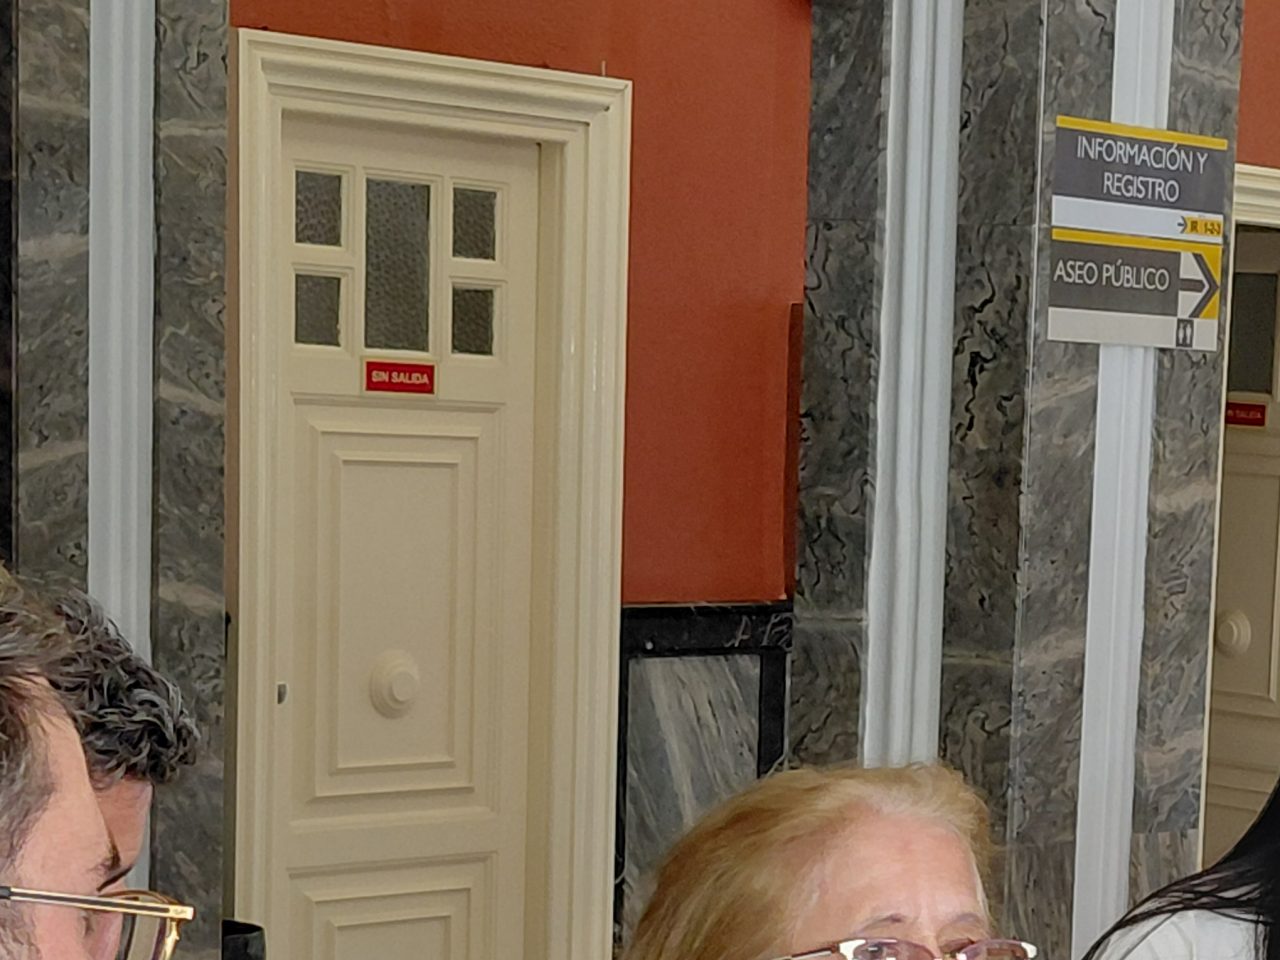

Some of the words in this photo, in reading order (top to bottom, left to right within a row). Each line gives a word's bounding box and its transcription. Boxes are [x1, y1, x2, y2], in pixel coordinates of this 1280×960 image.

[1077, 136, 1192, 173] INFORMACIÓN
[1196, 152, 1208, 174] Y
[1103, 172, 1179, 202] REGISTRO
[1053, 259, 1098, 284] ASEO
[1102, 259, 1169, 290] PÚBLICO
[391, 371, 430, 385] SALIDA
